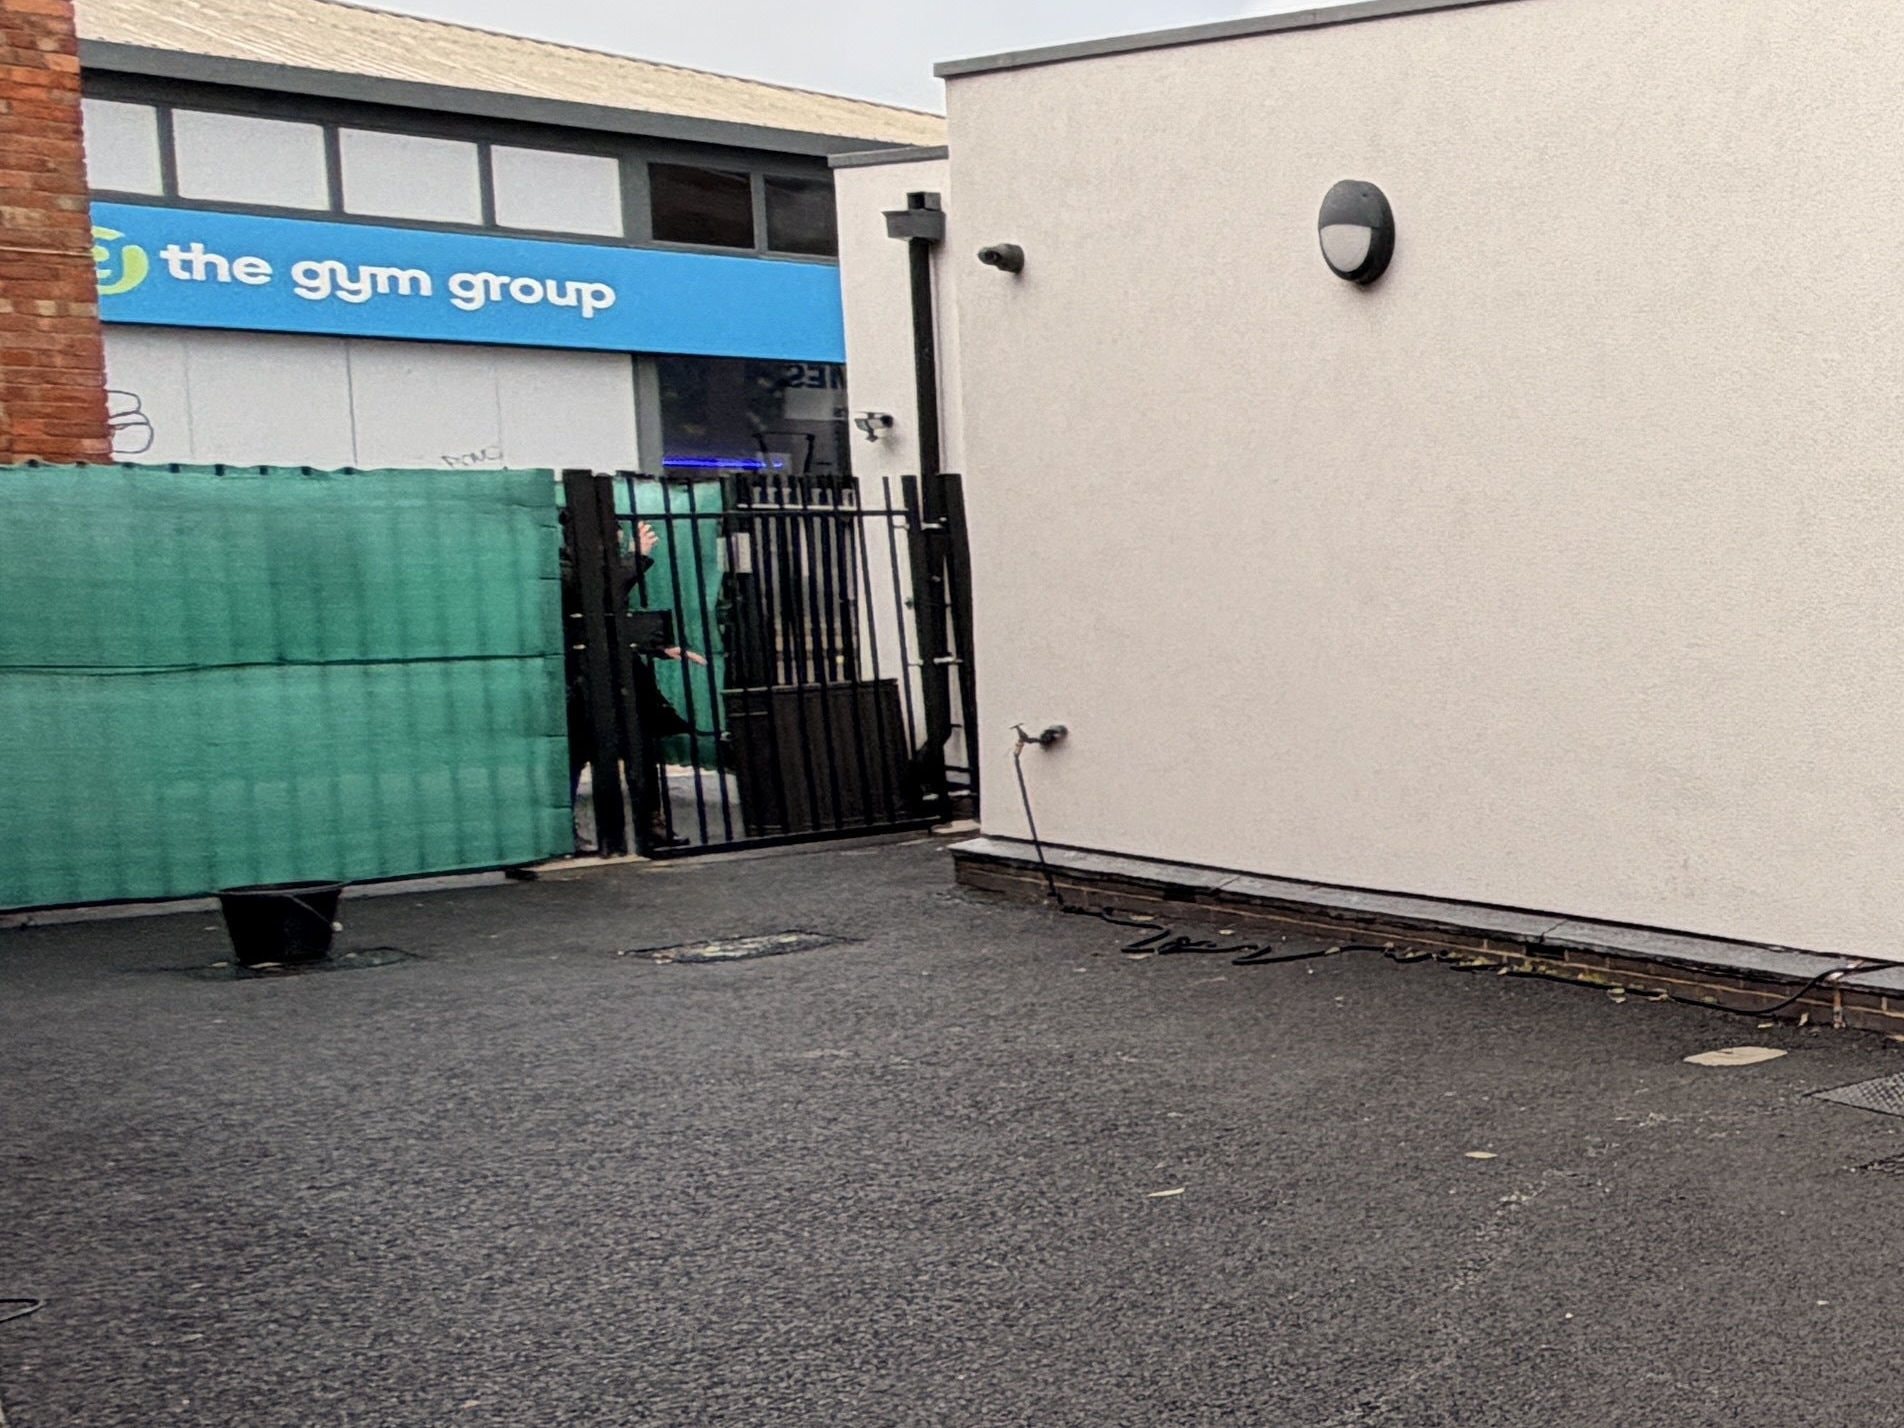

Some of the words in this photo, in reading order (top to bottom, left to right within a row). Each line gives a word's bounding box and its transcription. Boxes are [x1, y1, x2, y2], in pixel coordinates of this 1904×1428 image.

[160, 241, 272, 284] the
[290, 259, 433, 303] gym
[448, 270, 617, 319] group
